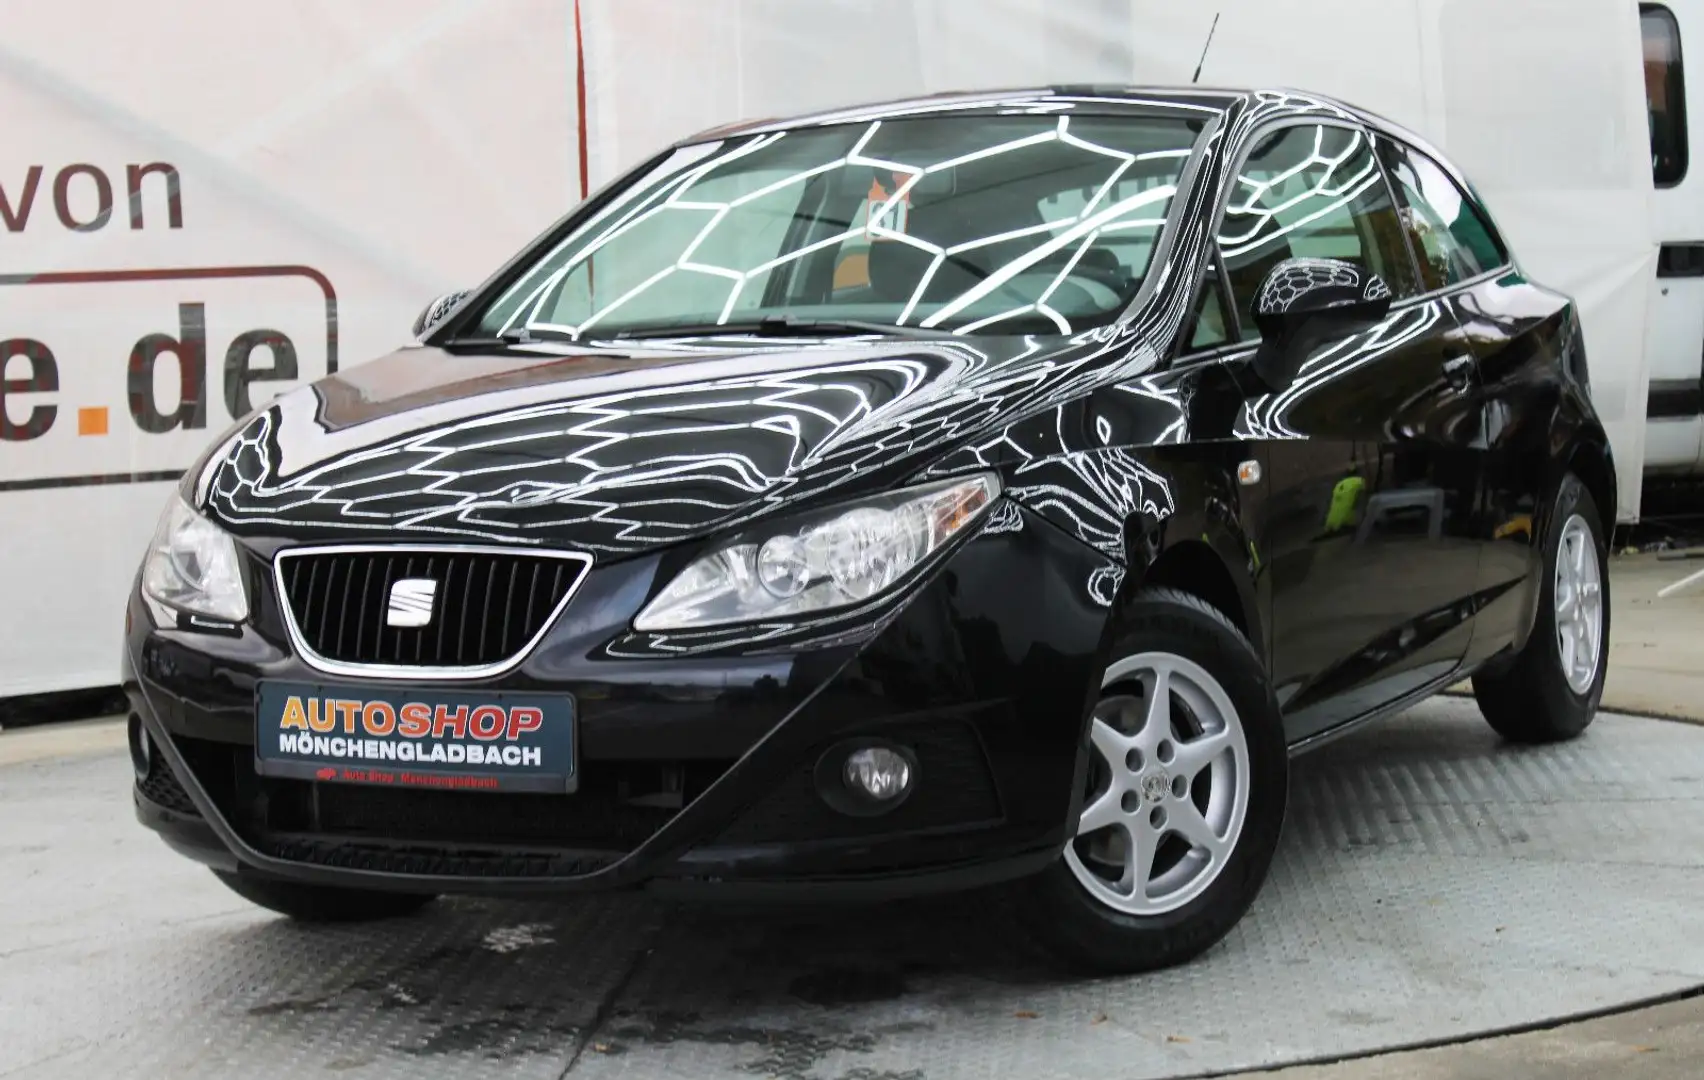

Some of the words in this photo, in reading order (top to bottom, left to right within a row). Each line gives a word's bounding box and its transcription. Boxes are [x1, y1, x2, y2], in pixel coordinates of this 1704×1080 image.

[0, 161, 183, 233] von
[279, 696, 544, 741] AUTOSHOP
[279, 731, 542, 767] MÖNCHENGLADBACH
